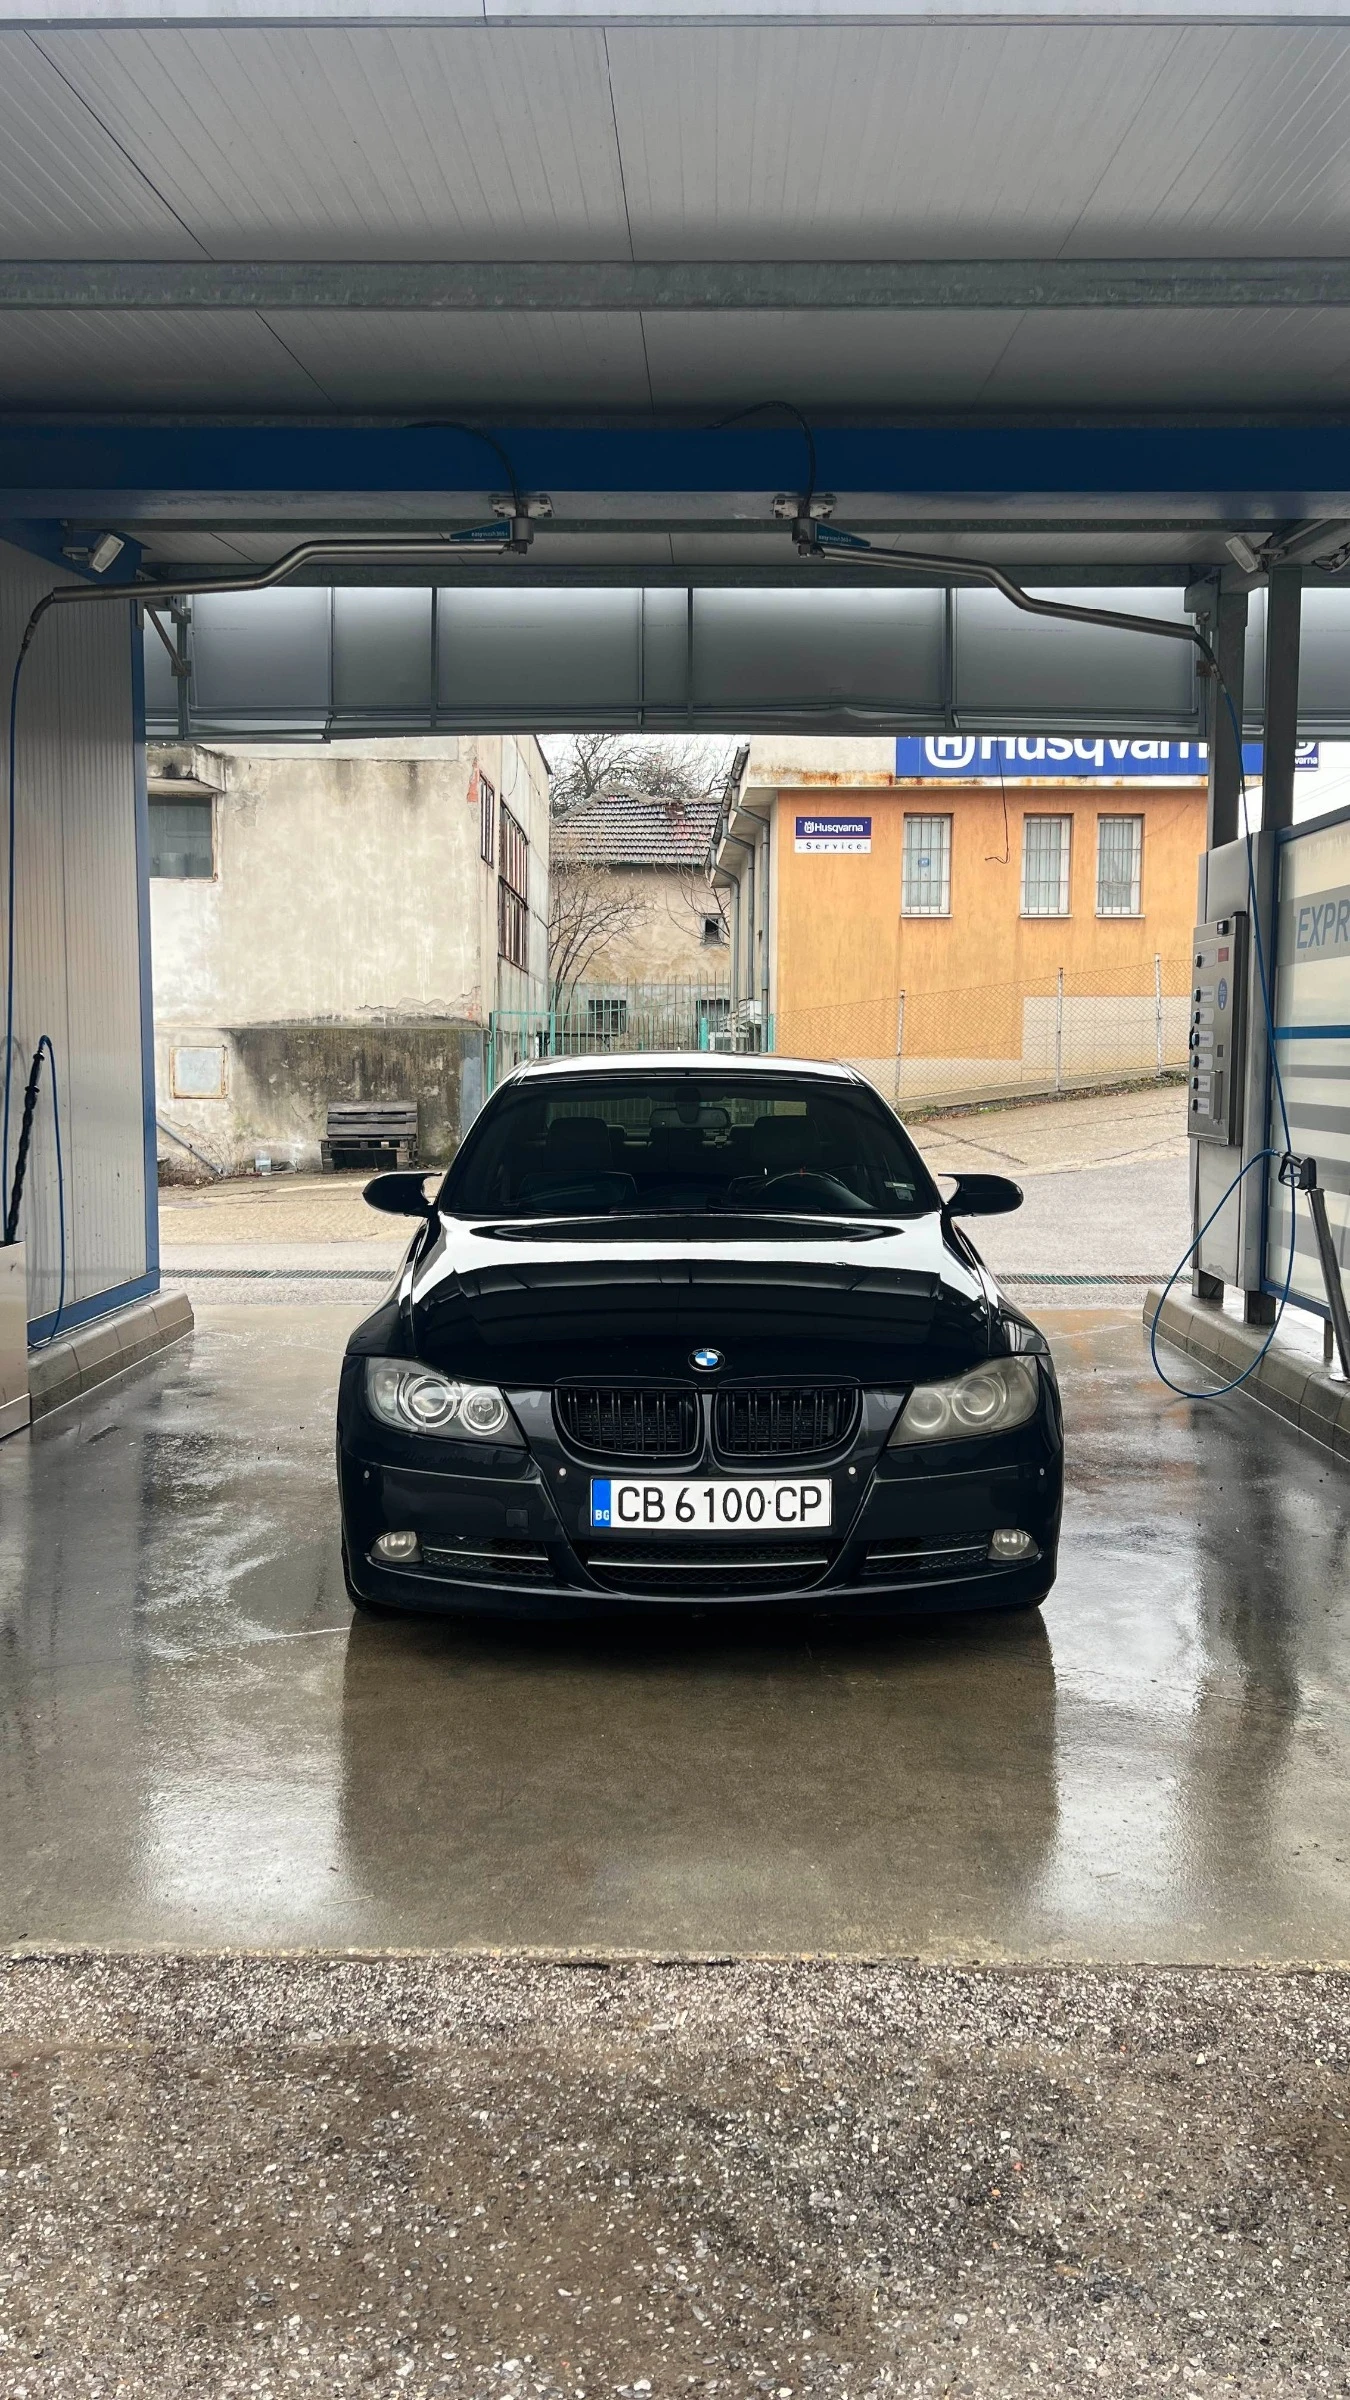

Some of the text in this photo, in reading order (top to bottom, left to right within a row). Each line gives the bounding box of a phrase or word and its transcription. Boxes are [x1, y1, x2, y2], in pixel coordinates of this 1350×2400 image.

[981, 736, 1209, 767] Husqvarn
[814, 822, 864, 833] Husqvarna
[806, 842, 862, 850] Service
[1297, 899, 1350, 949] EXPR
[595, 1510, 610, 1520] BG
[617, 1486, 822, 1523] CB 6100 CP
